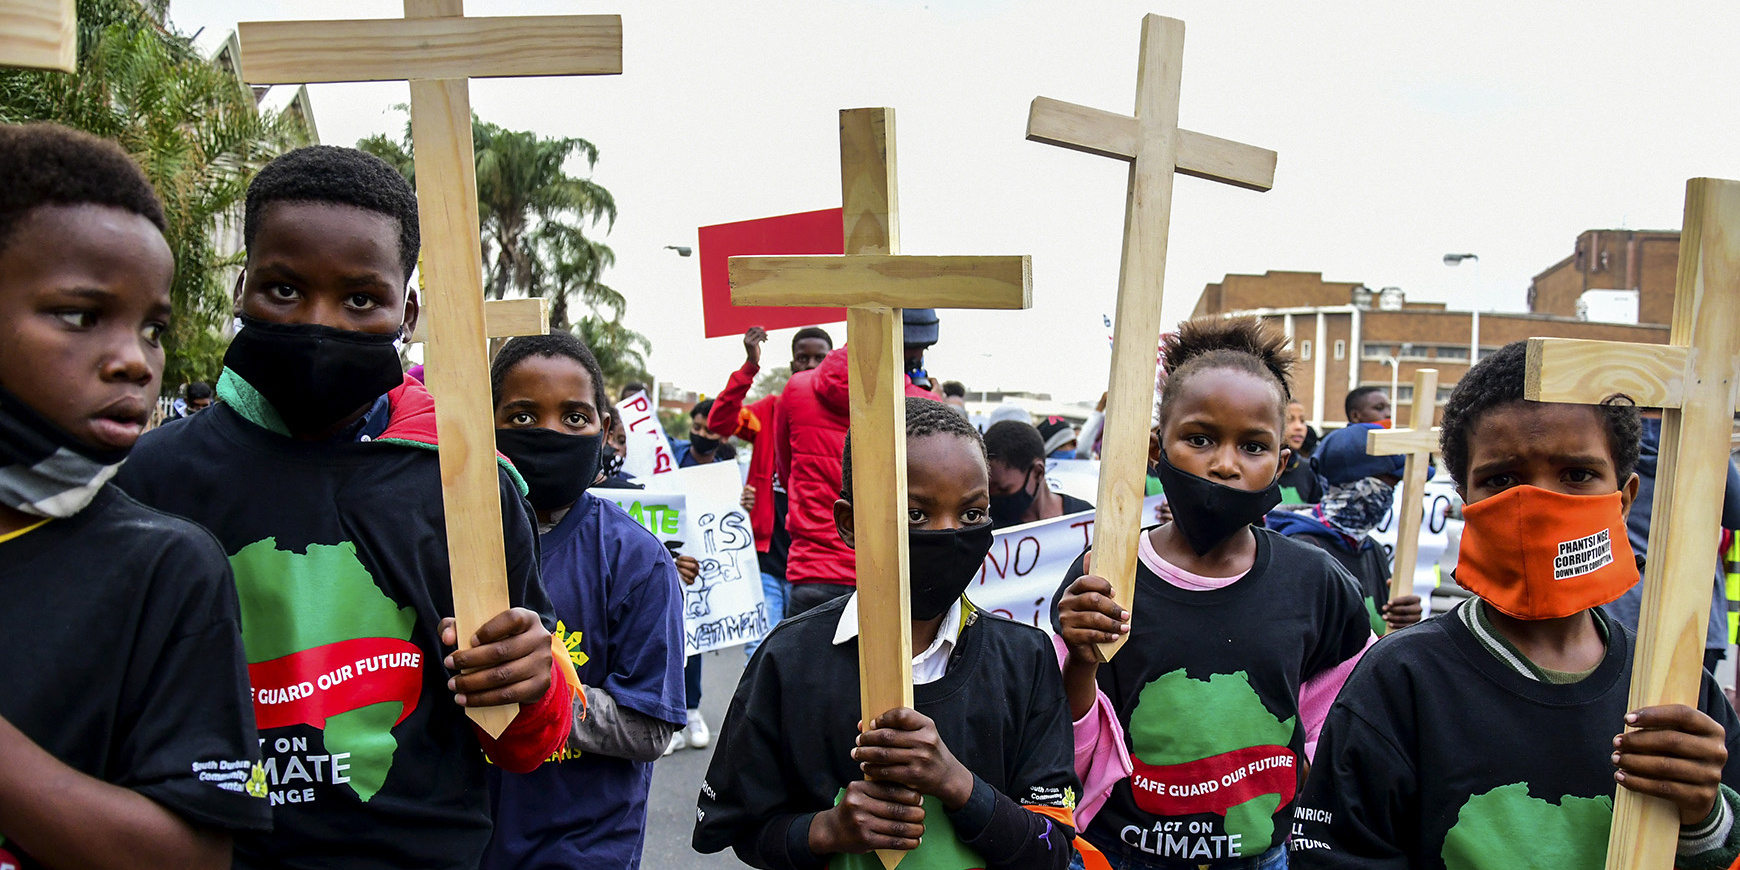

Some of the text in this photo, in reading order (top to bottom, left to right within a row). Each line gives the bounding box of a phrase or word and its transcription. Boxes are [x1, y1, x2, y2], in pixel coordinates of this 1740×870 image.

[617, 501, 680, 535] ATE
[1559, 535, 1596, 555] PHANTSI
[980, 536, 1040, 585] NO
[1555, 554, 1612, 579] DOWN WITH CORRUPTION
[258, 681, 314, 704] GUARD
[317, 665, 353, 690] OUR
[355, 652, 421, 676] FUTURE
[275, 737, 308, 753] ON
[1133, 755, 1294, 797] SAFE GUARD OUR FUTURE
[269, 788, 315, 806] NGE
[1152, 821, 1213, 834] ACT ON
[1293, 806, 1332, 825] INRICH
[1120, 824, 1243, 859] CLIMATE
